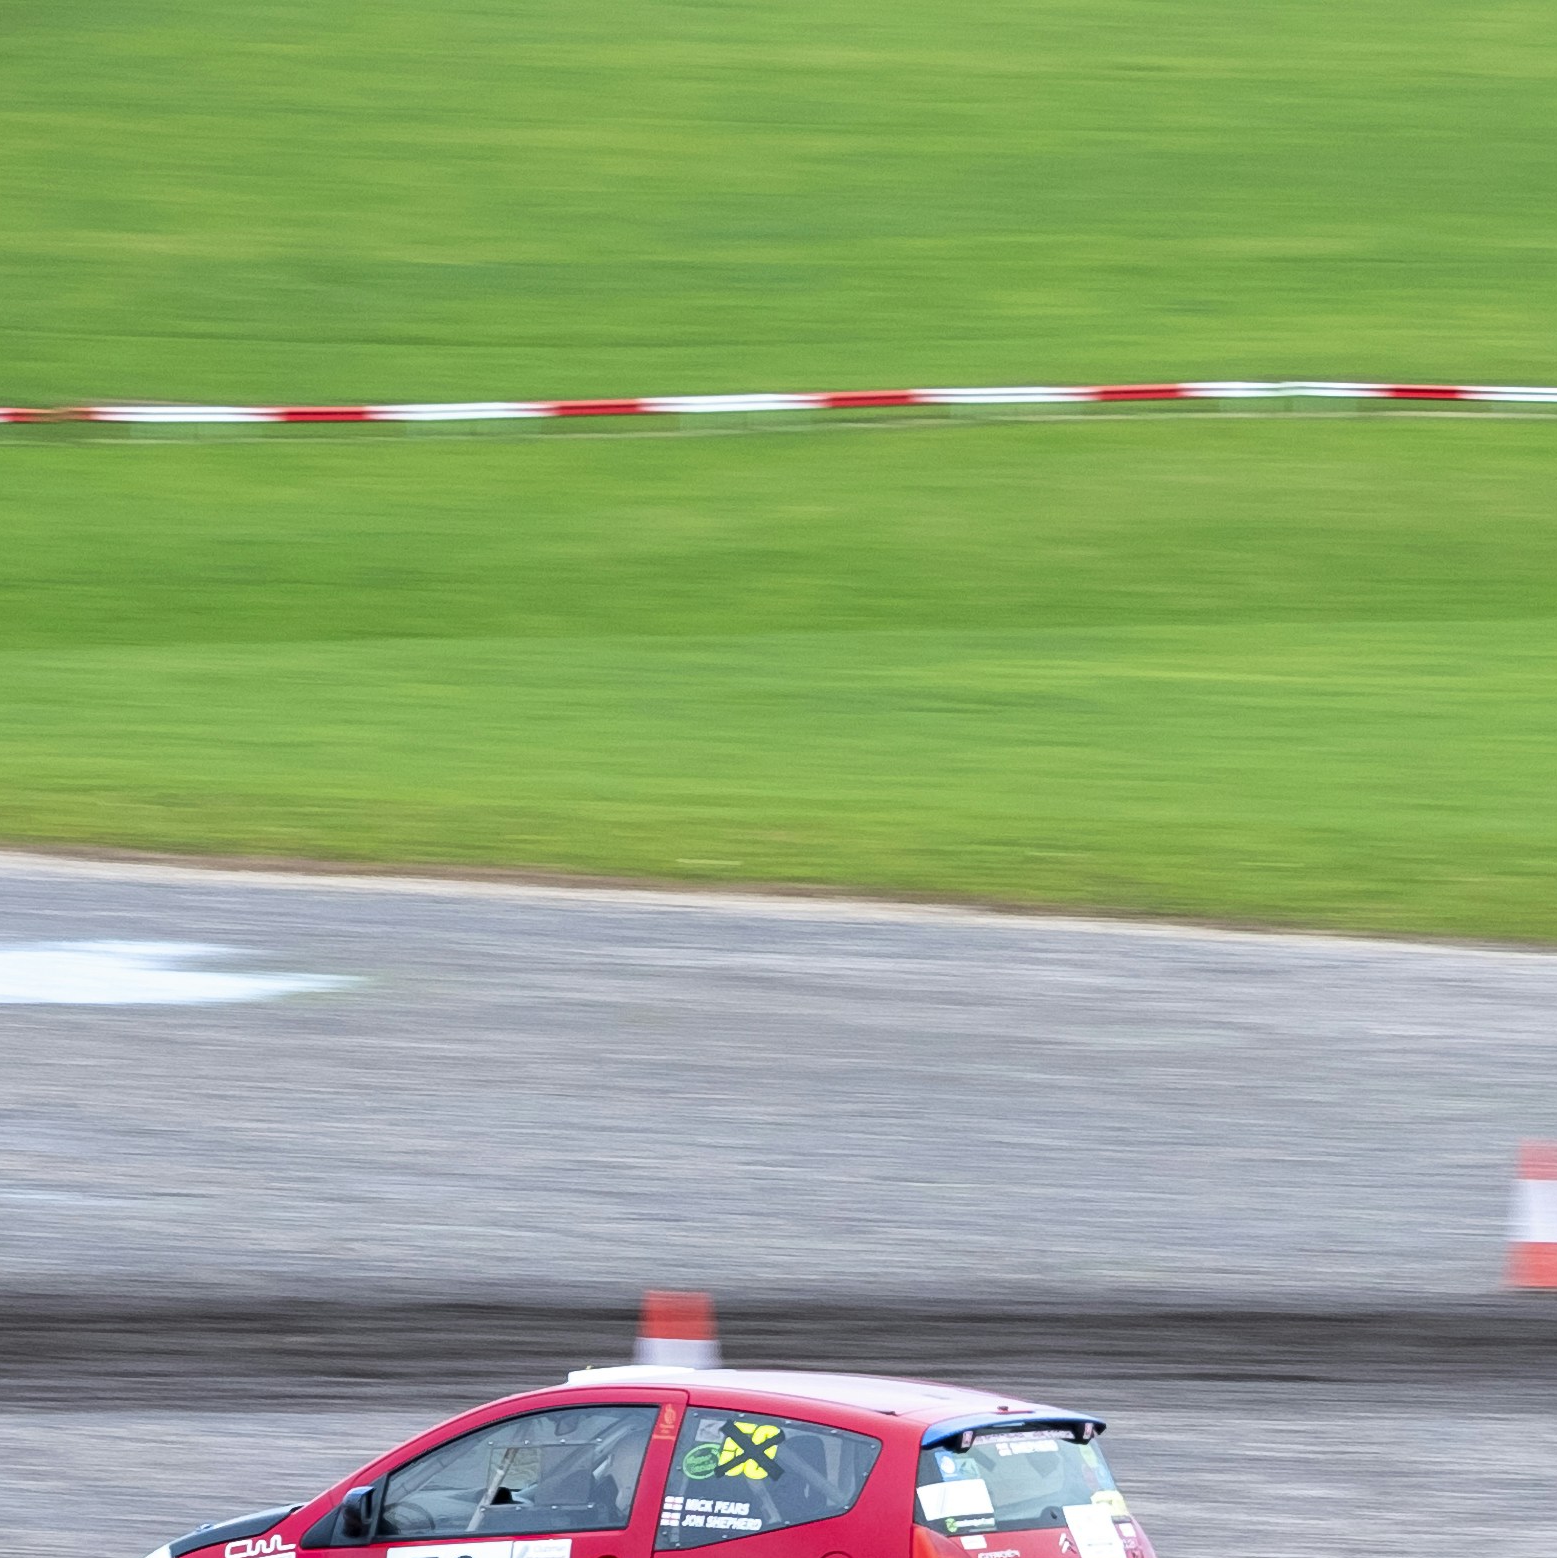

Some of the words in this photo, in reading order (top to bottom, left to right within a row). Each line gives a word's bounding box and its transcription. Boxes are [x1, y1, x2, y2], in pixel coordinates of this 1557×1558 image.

[685, 1499, 713, 1512] MICK
[714, 1500, 750, 1515] PEARS
[682, 1515, 705, 1527] JON
[706, 1515, 762, 1530] SHEPHERD
